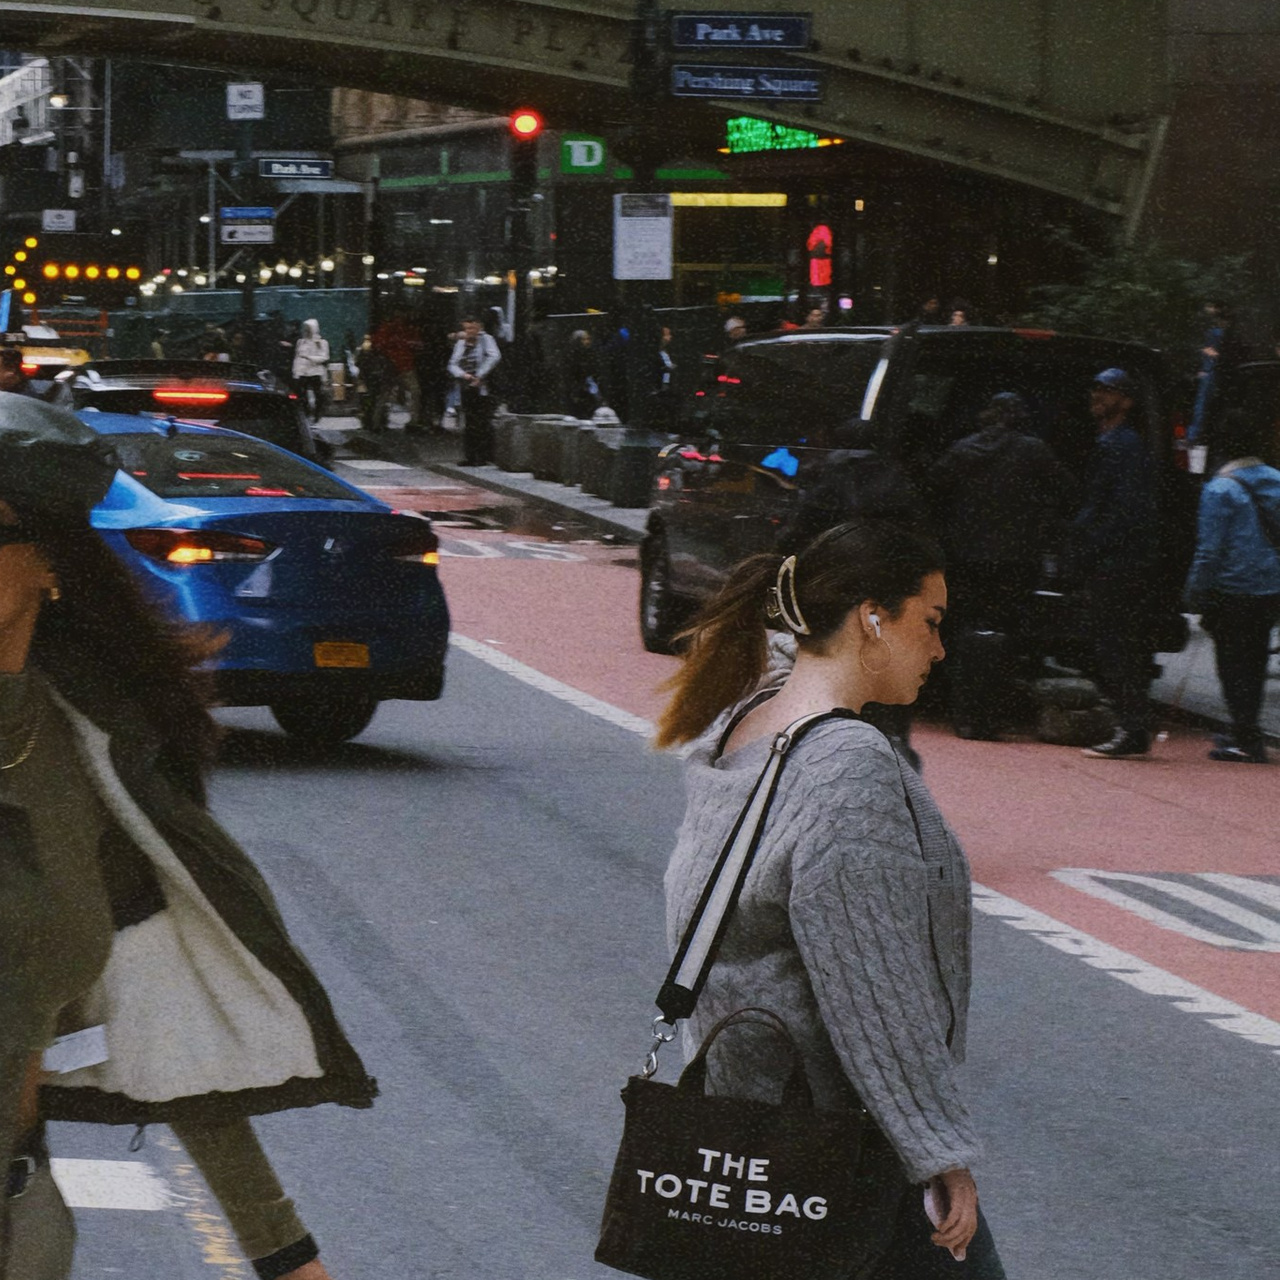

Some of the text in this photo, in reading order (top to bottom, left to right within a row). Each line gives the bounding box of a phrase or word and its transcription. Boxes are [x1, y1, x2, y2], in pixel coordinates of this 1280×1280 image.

[695, 23, 785, 41] Park Ave
[674, 71, 819, 95] Pershing Square
[564, 140, 603, 167] TD
[698, 1147, 770, 1182] THE
[637, 1169, 828, 1220] TOTE BAG
[667, 1208, 783, 1235] MARC JACOBS
